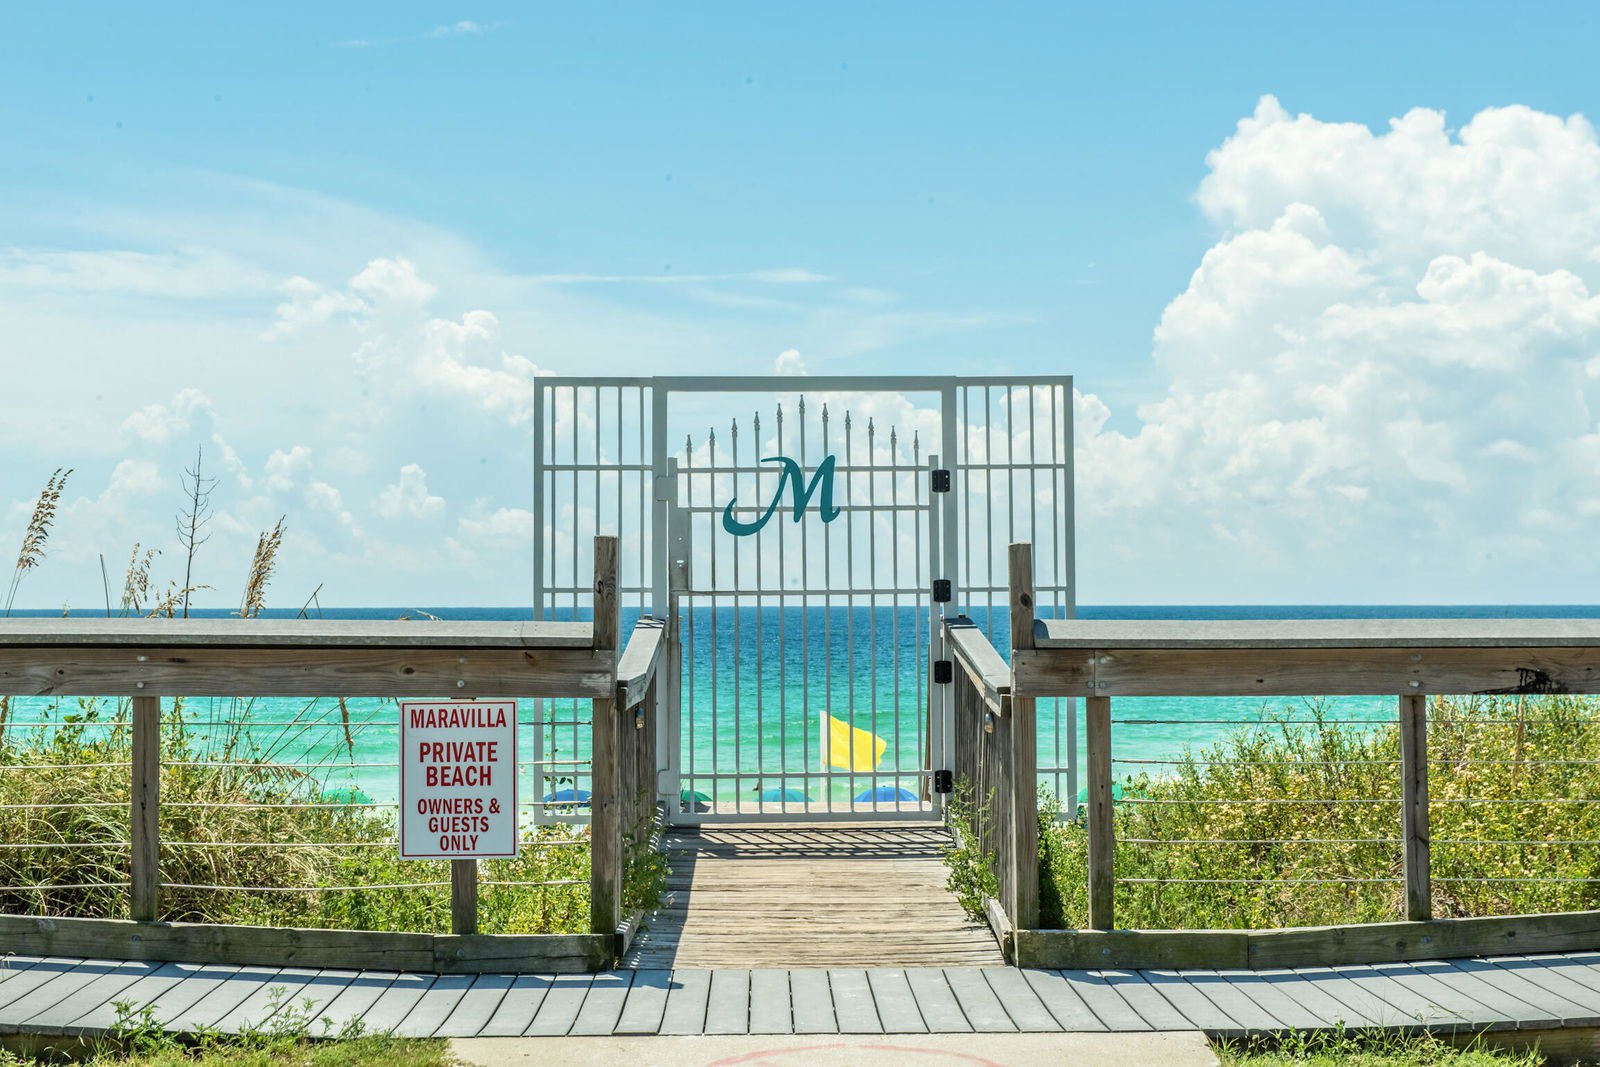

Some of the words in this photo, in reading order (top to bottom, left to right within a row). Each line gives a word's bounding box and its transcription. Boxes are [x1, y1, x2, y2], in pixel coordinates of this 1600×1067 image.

[722, 454, 842, 537] M
[410, 708, 507, 729] MARAVILLA
[419, 741, 498, 763] PRIVATE
[426, 766, 492, 787] BEACH
[417, 798, 484, 815] OWNERS
[488, 797, 500, 814] &
[428, 816, 489, 833] GUESTS
[439, 835, 479, 851] ONLY
